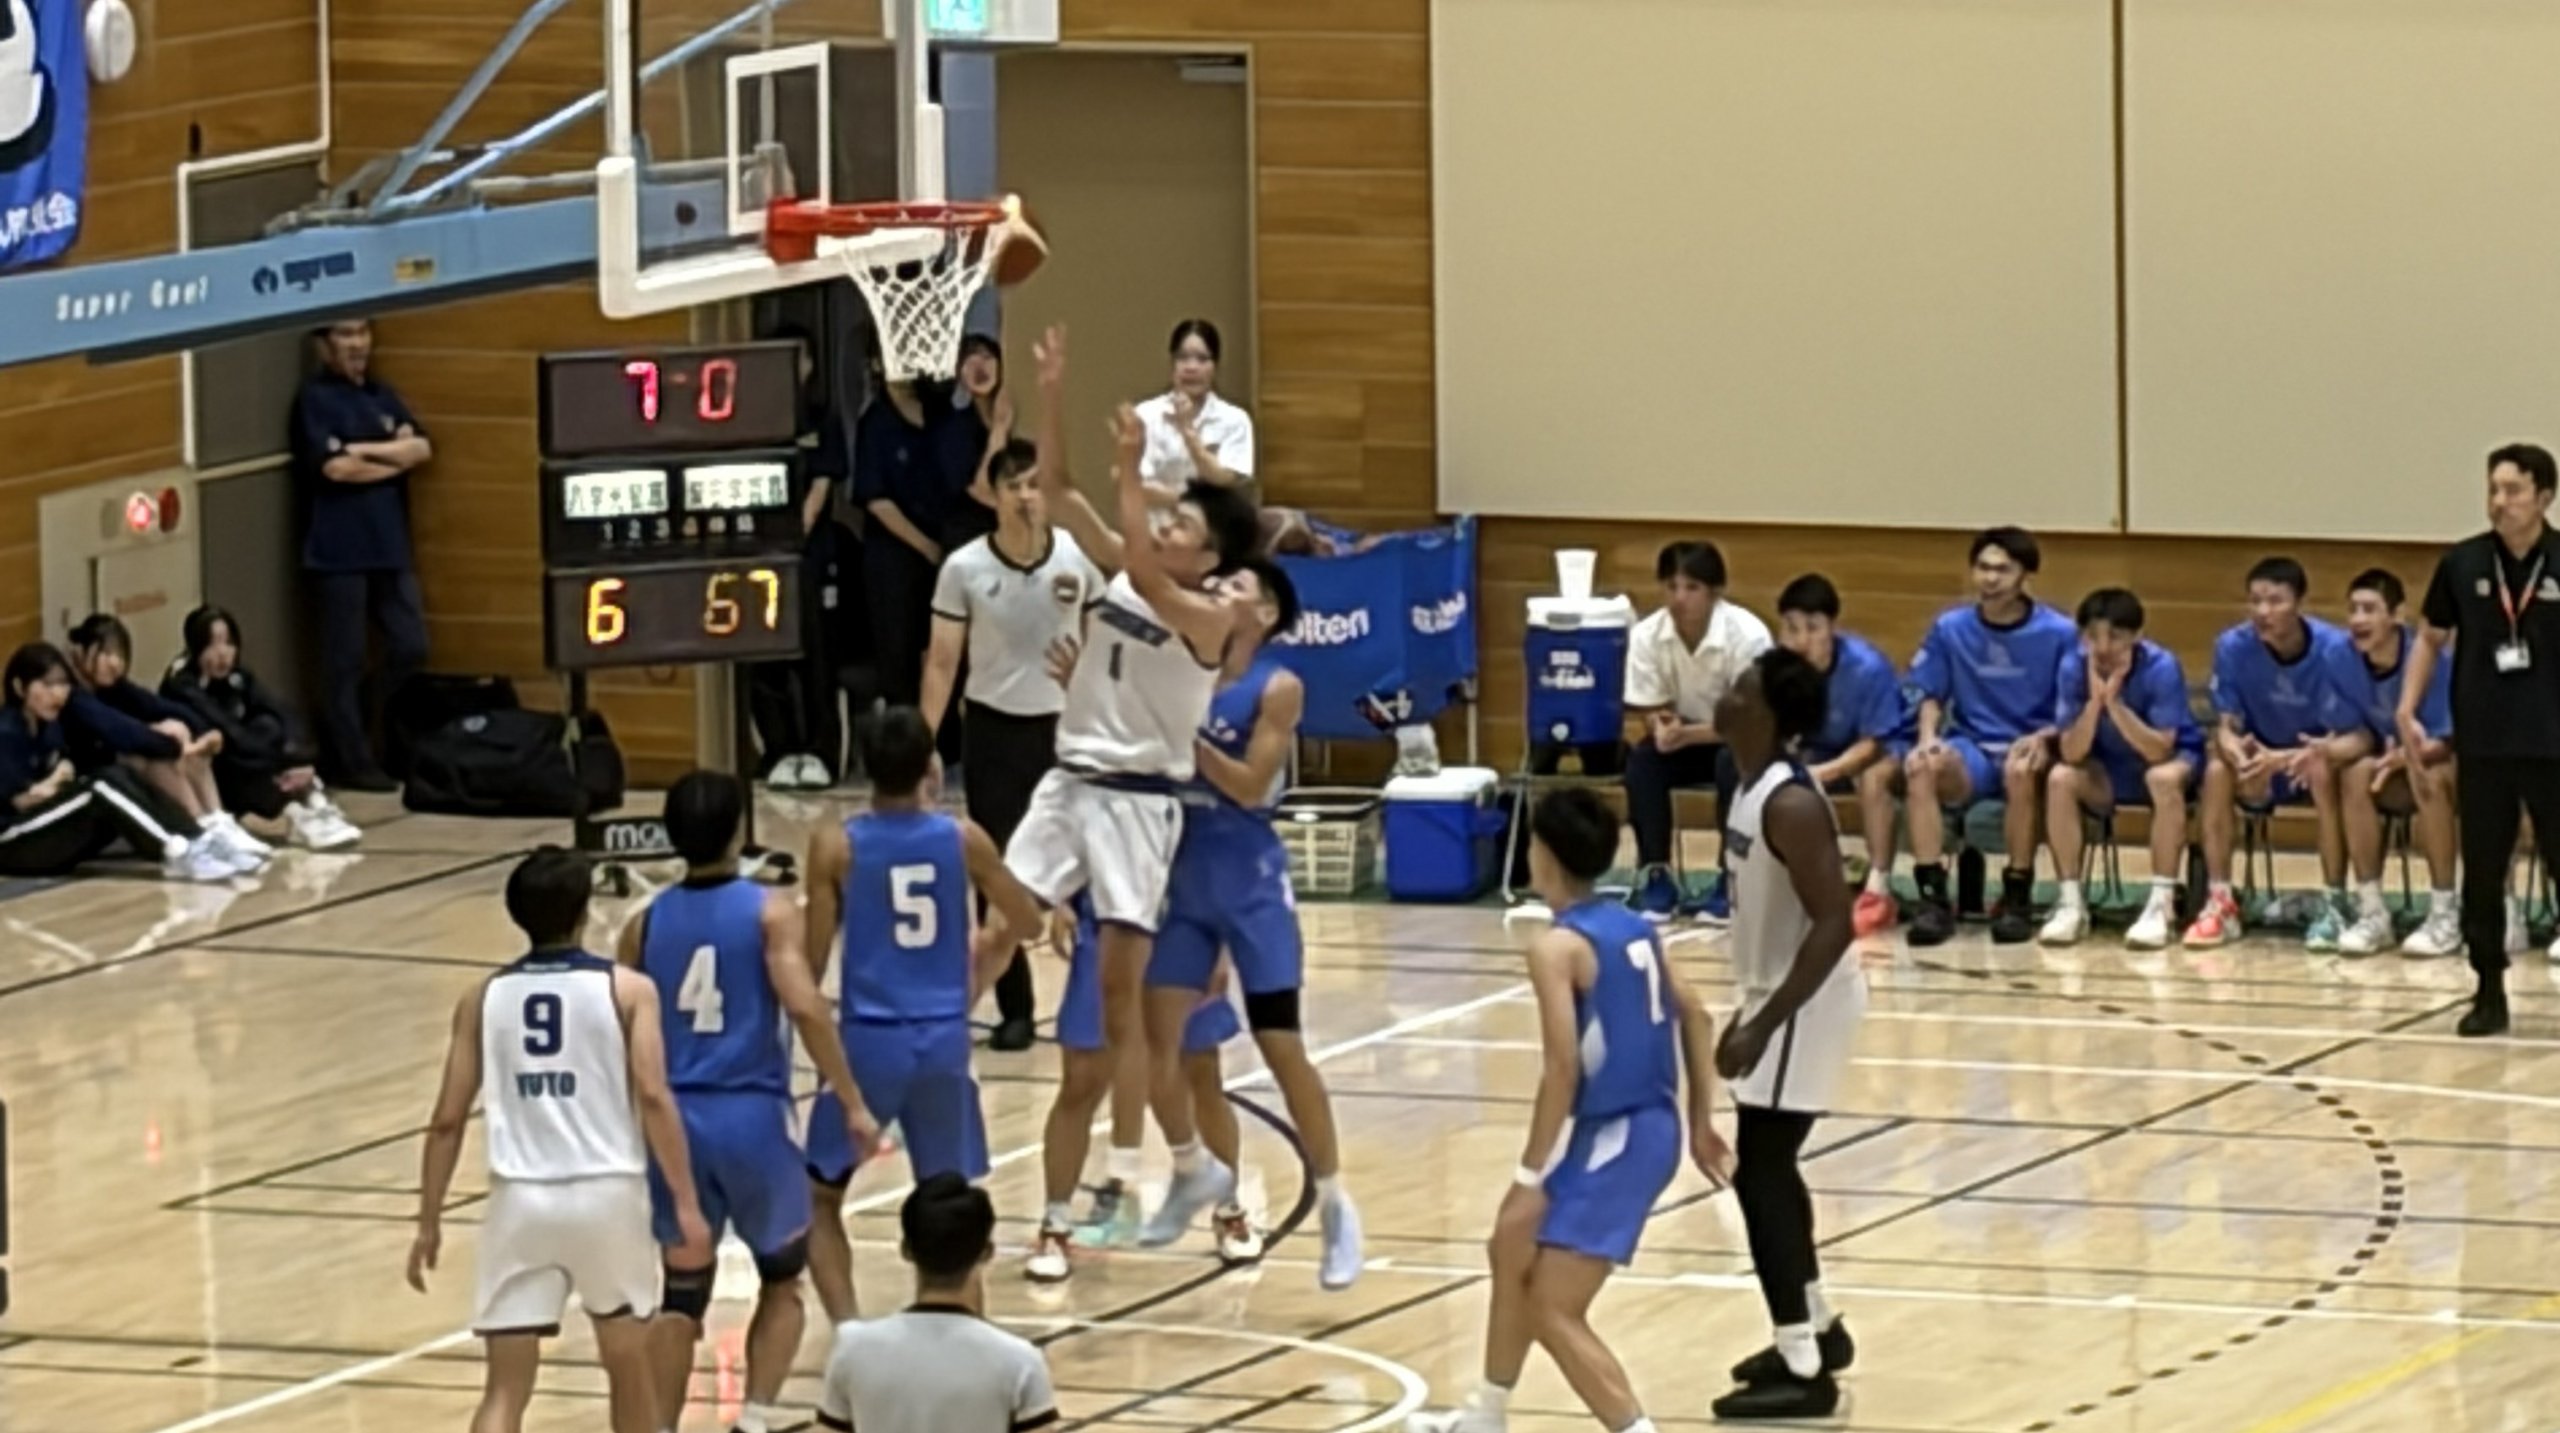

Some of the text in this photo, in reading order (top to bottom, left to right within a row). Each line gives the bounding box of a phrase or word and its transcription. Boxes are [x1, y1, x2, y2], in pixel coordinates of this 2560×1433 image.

[586, 577, 625, 645] 6
[889, 863, 938, 949] 5
[677, 945, 725, 1034] 4
[523, 993, 563, 1057] 9
[515, 1070, 576, 1099] YUTO
